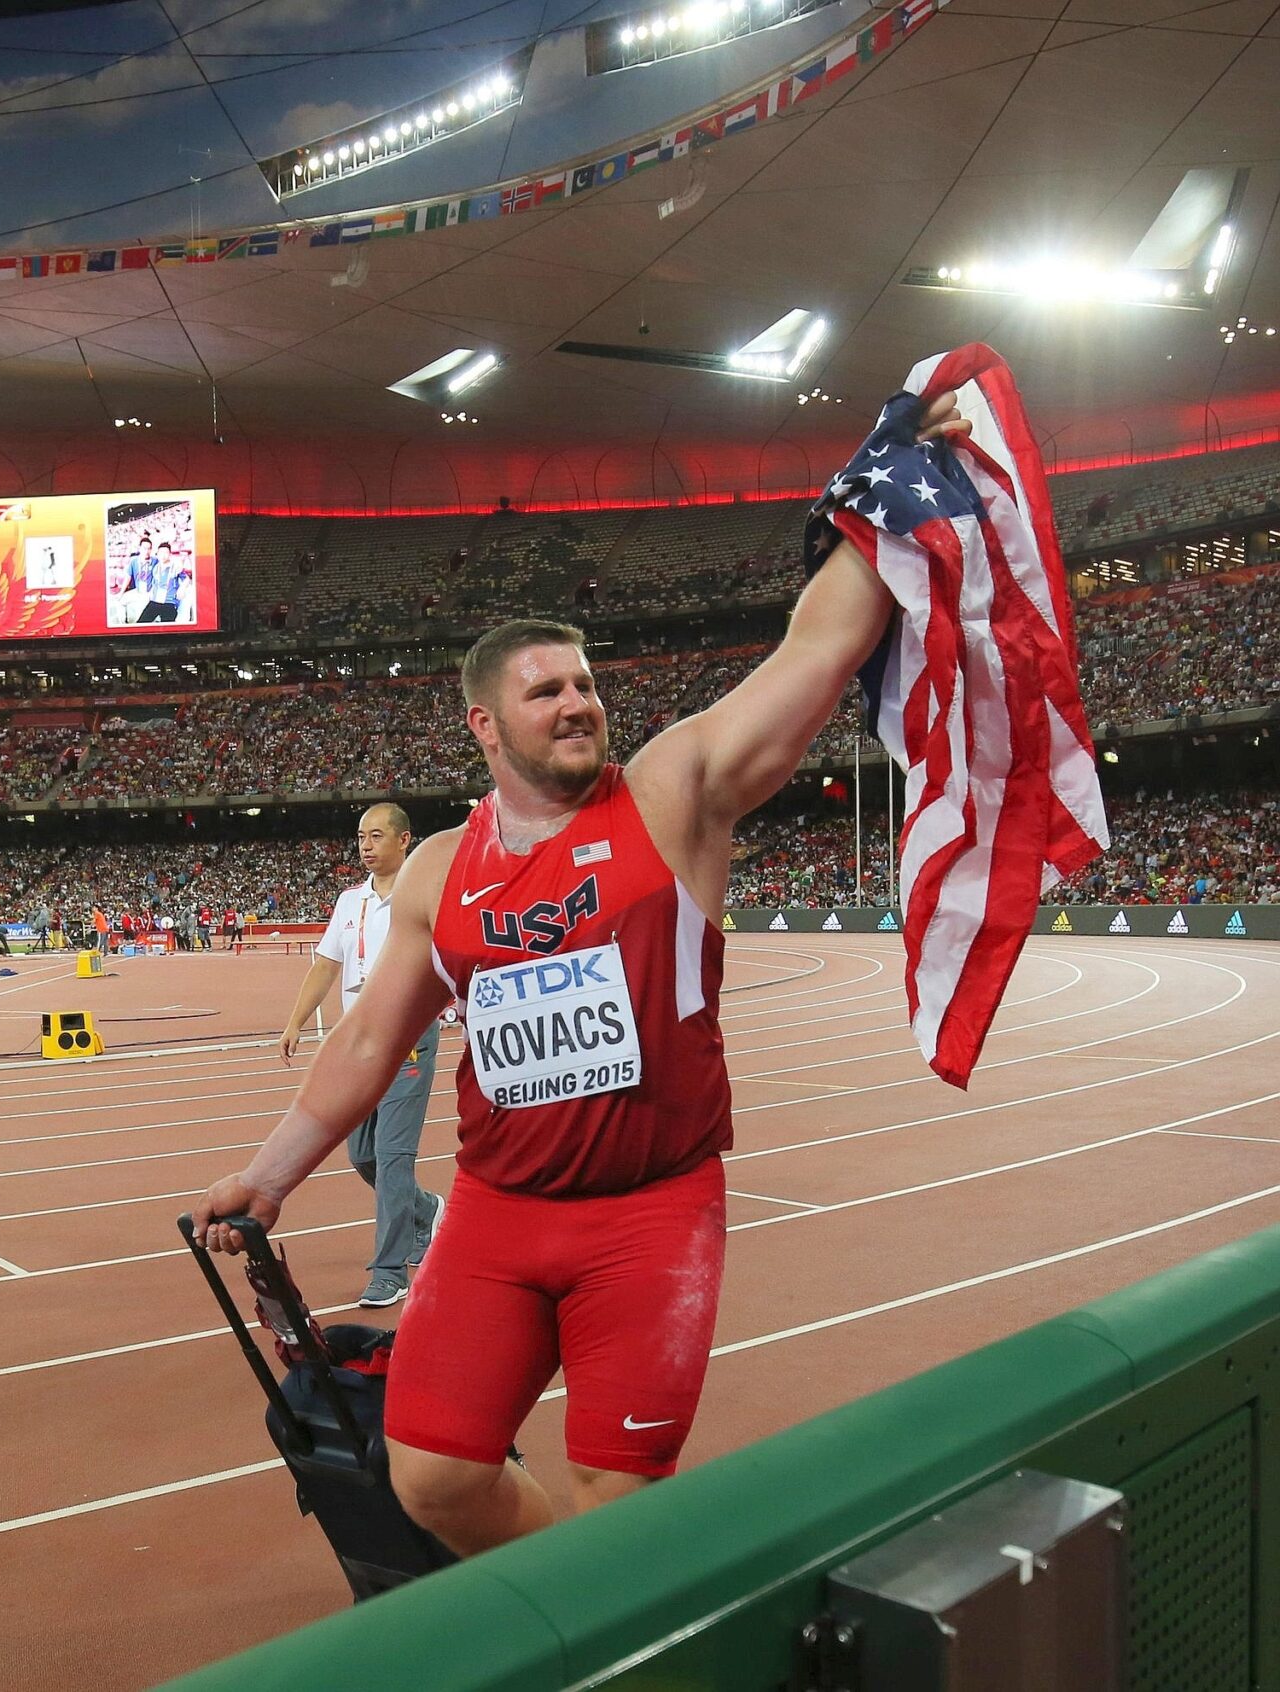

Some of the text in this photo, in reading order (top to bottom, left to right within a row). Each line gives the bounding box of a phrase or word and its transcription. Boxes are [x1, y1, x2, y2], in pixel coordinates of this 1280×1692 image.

[480, 873, 600, 956] USA
[1109, 925, 1131, 933] adidas
[1167, 926, 1189, 934] adidas
[1225, 927, 1247, 935] adidas
[500, 952, 610, 1000] TDK
[476, 1001, 625, 1073] KOVACS
[494, 1060, 635, 1106] BEIJING 2015
